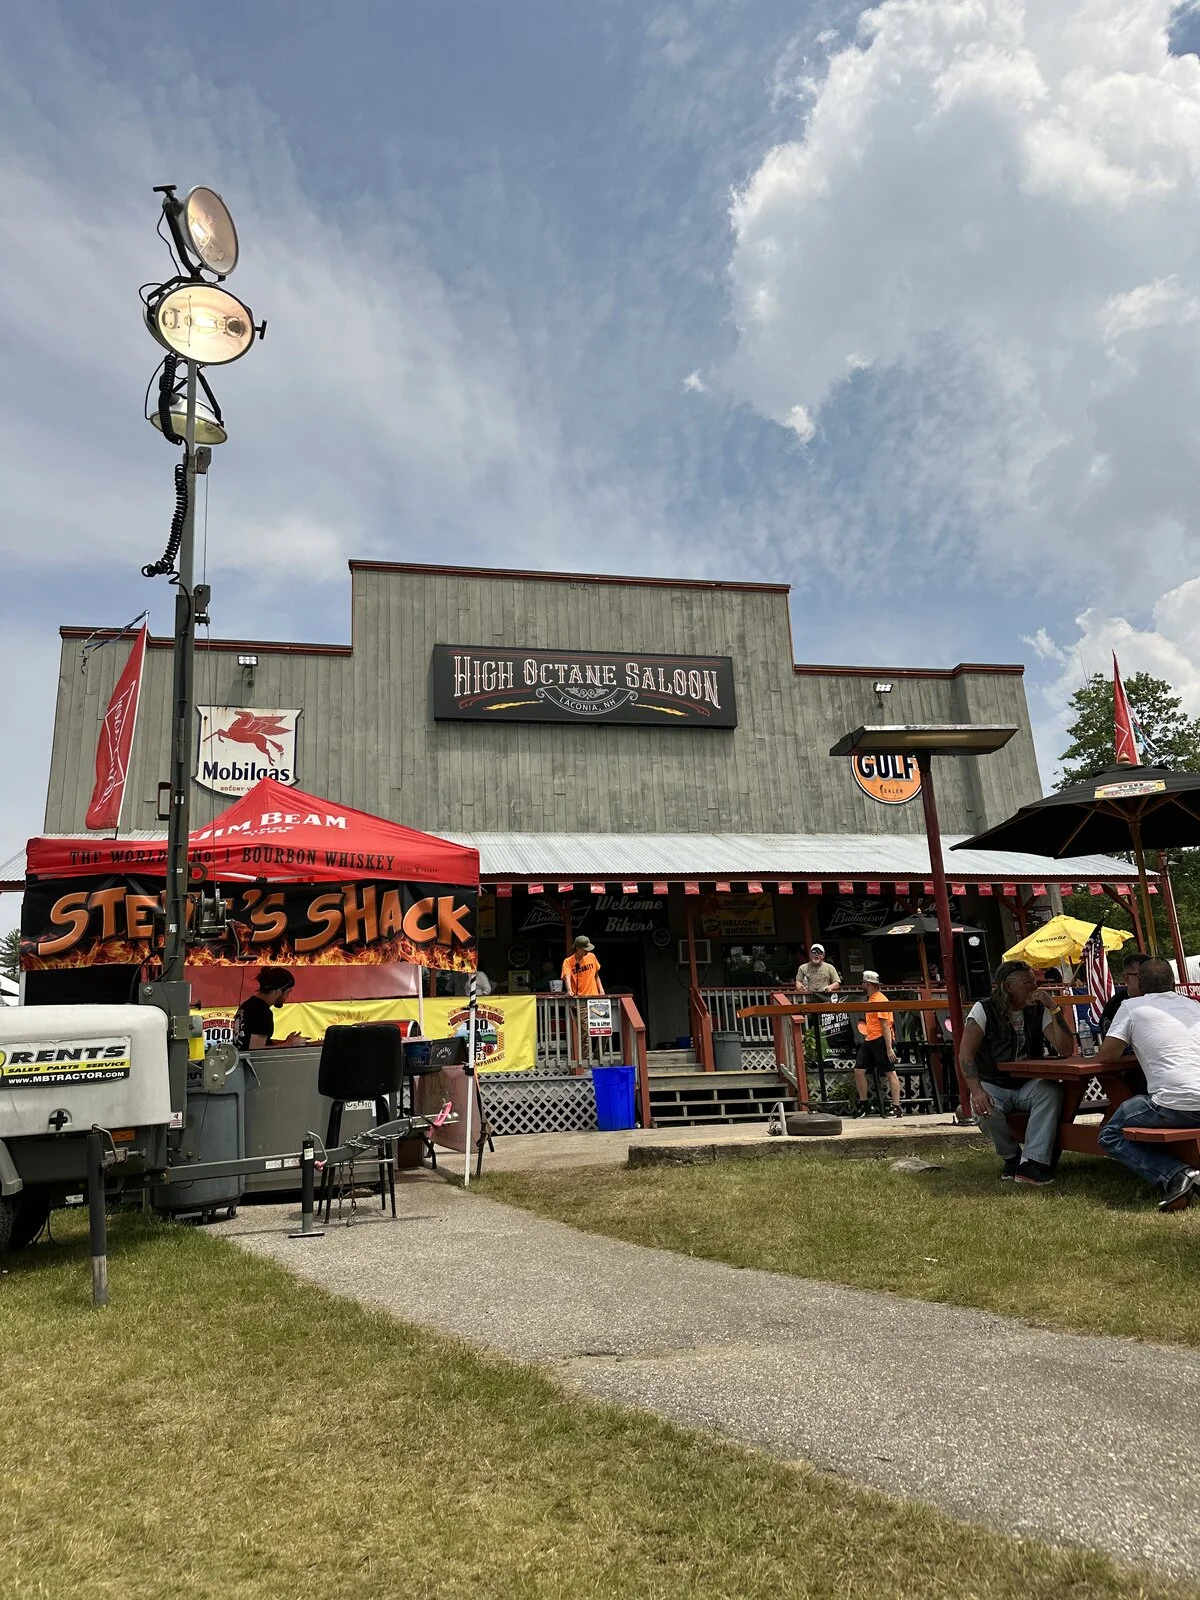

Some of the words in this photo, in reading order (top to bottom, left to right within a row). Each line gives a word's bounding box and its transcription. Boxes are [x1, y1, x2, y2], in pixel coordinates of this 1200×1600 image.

[453, 655, 514, 697] HIGH
[522, 658, 617, 687] OCTANE
[625, 662, 721, 709] SALOON
[560, 697, 602, 711] LACONIA,
[603, 698, 616, 709] NH
[203, 761, 290, 781] Mobilgas
[857, 754, 918, 780] GULF
[881, 786, 904, 794] EALER
[188, 820, 252, 842] JIM
[259, 812, 348, 829] BEAM
[69, 850, 102, 866] THE
[225, 848, 231, 863] 1
[241, 846, 317, 866] BOURBON
[324, 851, 396, 871] WHISKEY
[595, 896, 664, 911] Welcome
[294, 884, 473, 952] SHACK
[605, 916, 655, 932] Bikers
[834, 911, 885, 924] Budweiser
[205, 1028, 231, 1040] 100
[10, 1046, 126, 1064] RENTS
[475, 1055, 501, 1067] MPSHIRE
[8, 1066, 41, 1074] SALES
[85, 1061, 126, 1069] SERVICE
